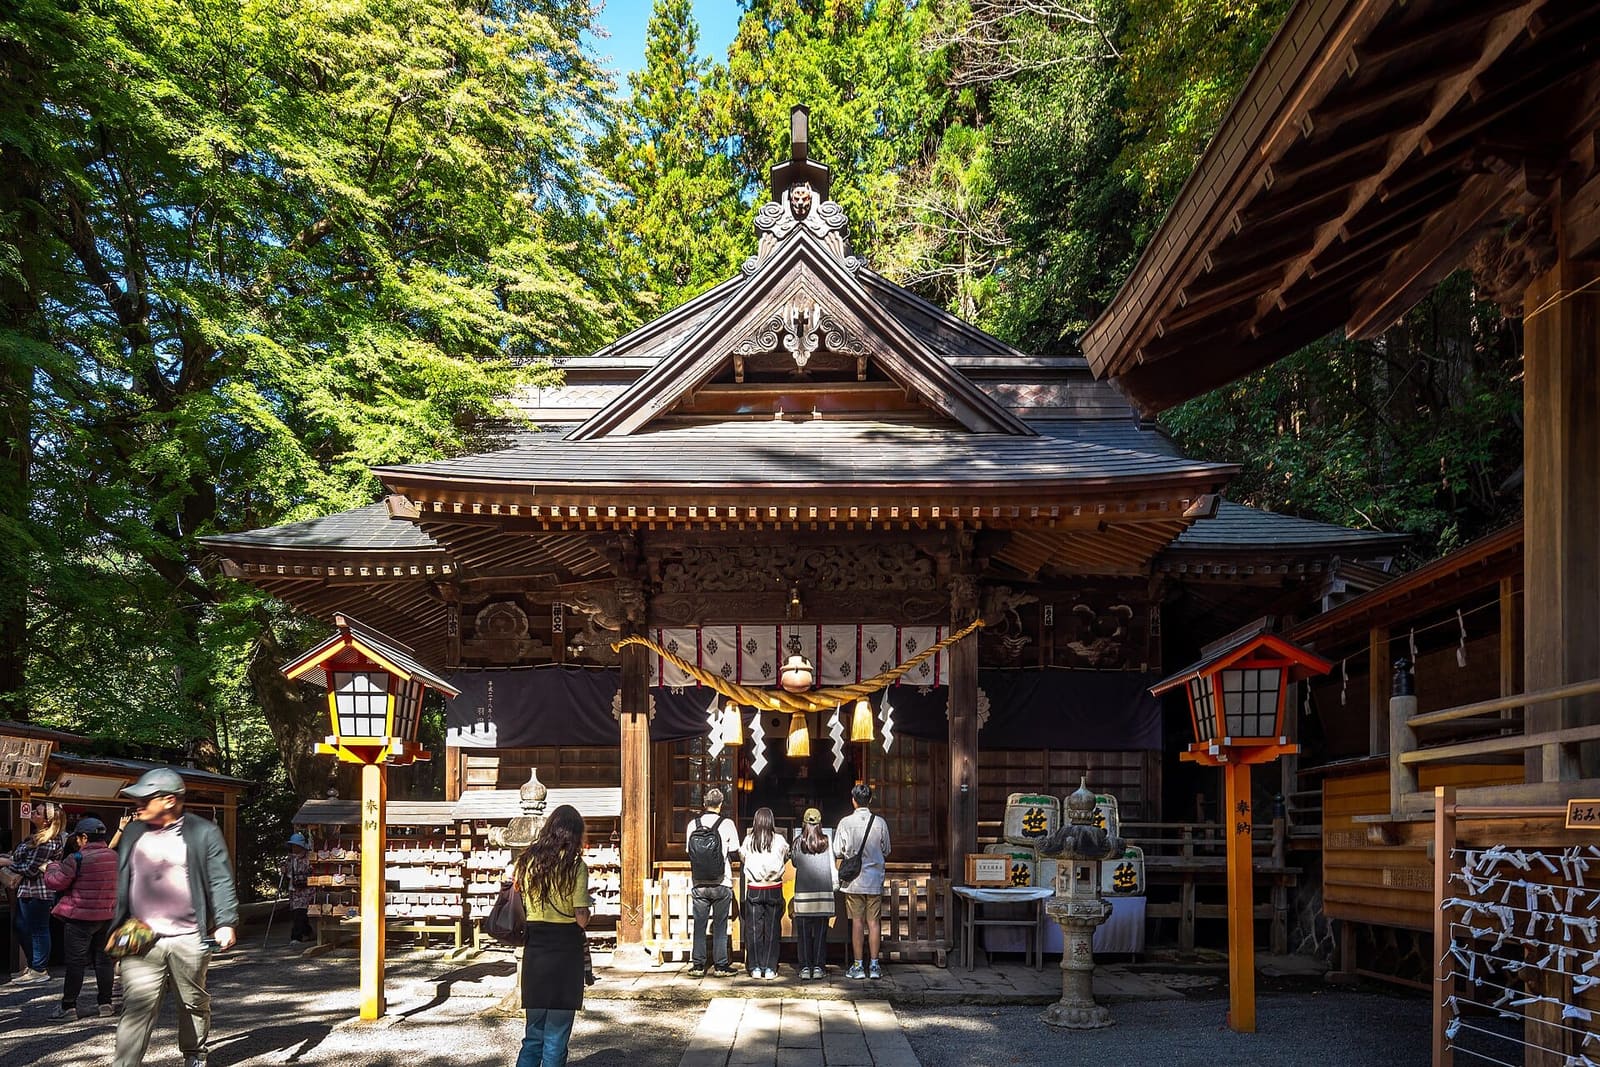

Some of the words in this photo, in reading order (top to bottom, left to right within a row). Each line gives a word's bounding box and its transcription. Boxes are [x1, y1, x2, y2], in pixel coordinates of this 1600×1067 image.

[365, 799, 378, 831] 奉納
[1235, 799, 1250, 835] 奉納
[1572, 807, 1600, 821] おみ
